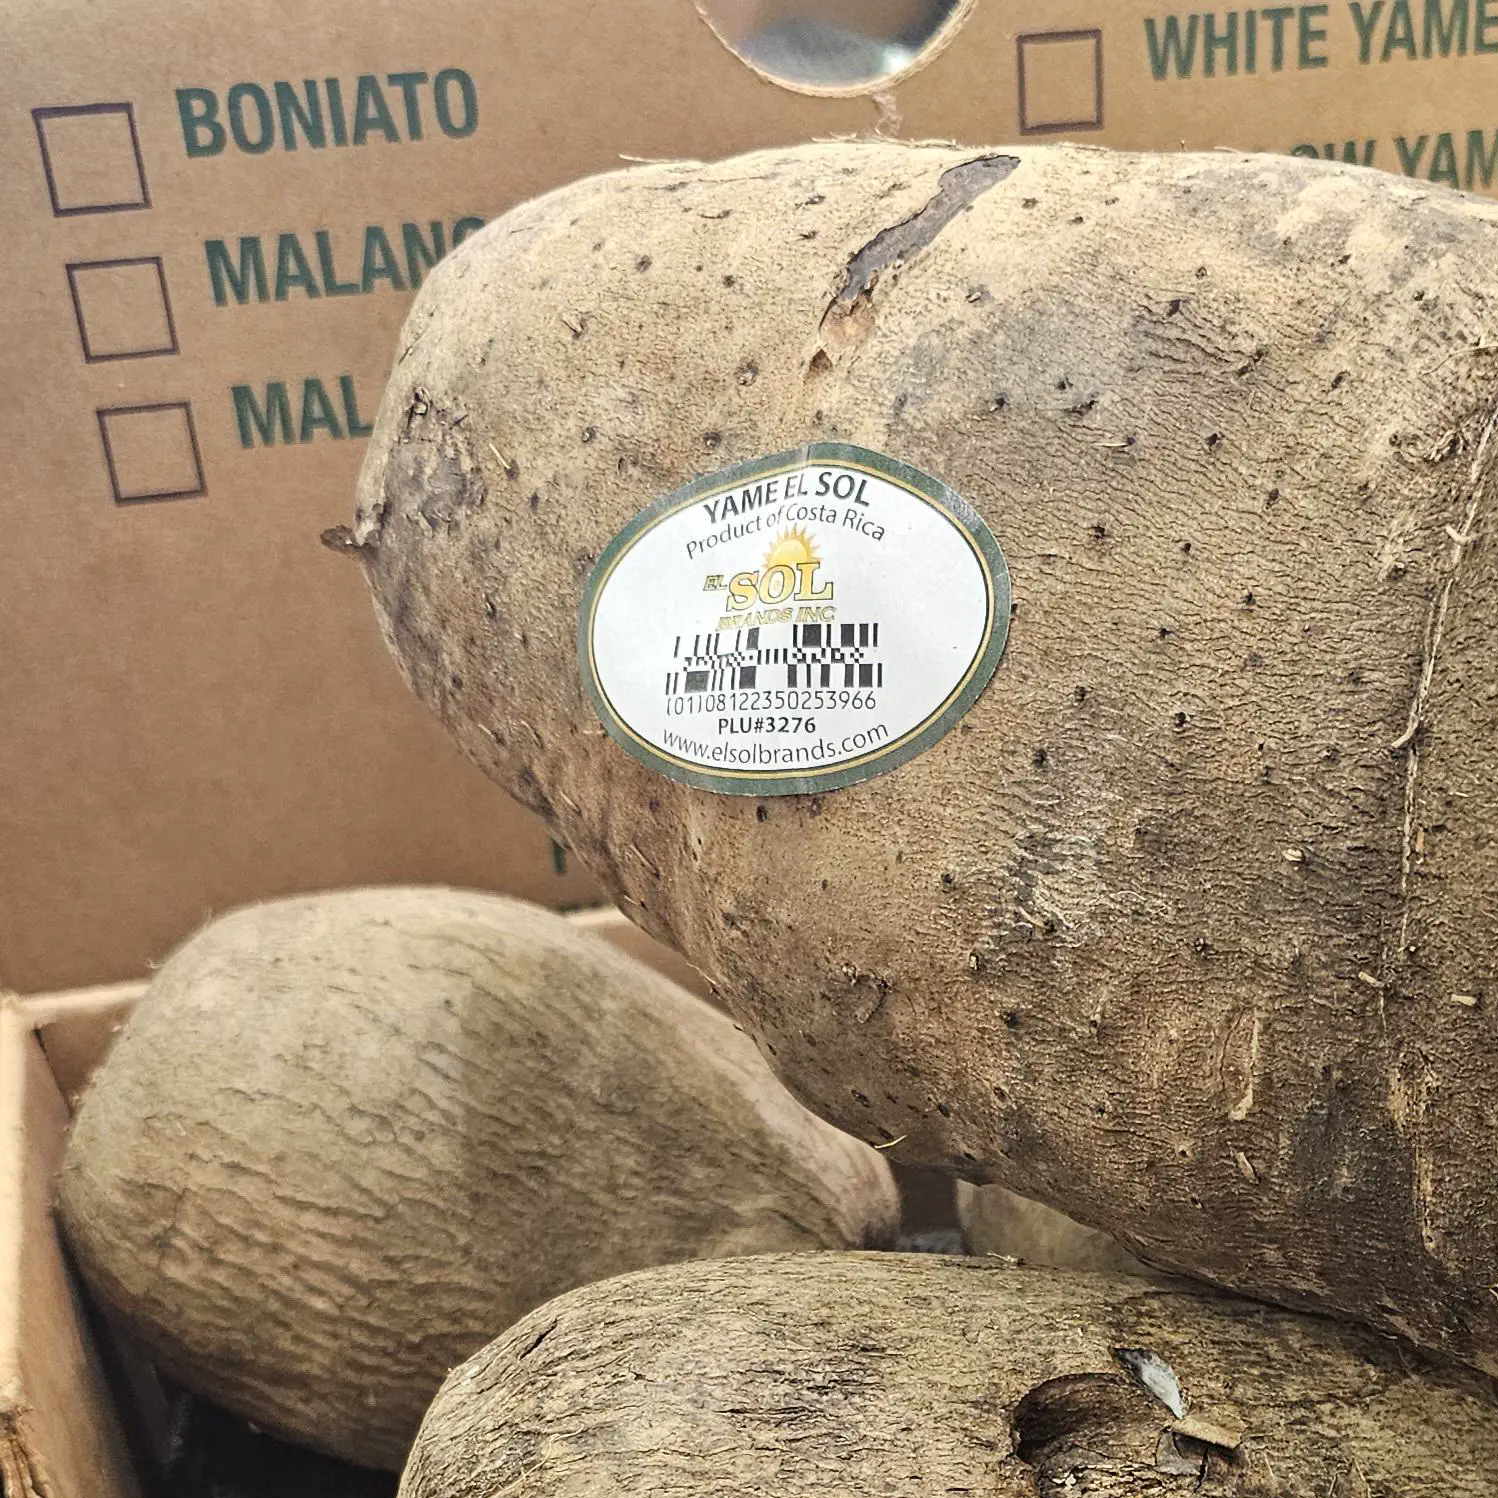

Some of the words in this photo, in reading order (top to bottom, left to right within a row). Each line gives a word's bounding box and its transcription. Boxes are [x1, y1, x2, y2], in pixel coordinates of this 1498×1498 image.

[1144, 3, 1329, 82] WHITE
[174, 67, 481, 159] BONIATO
[230, 374, 374, 450] MAL
[702, 479, 779, 524] YAME
[783, 473, 809, 500] EL
[814, 470, 871, 508] SOL
[686, 514, 762, 560] Product
[766, 504, 785, 528] of
[785, 502, 837, 524] Costa
[842, 508, 886, 542] Rica
[703, 574, 728, 592] EL
[726, 561, 834, 612] SOL
[715, 606, 794, 632] BRANDS
[795, 605, 837, 623] INC
[666, 690, 877, 716] (01)08122350253966
[718, 716, 817, 735] PLU#3276
[663, 723, 889, 765] www.elsolbrands.com
